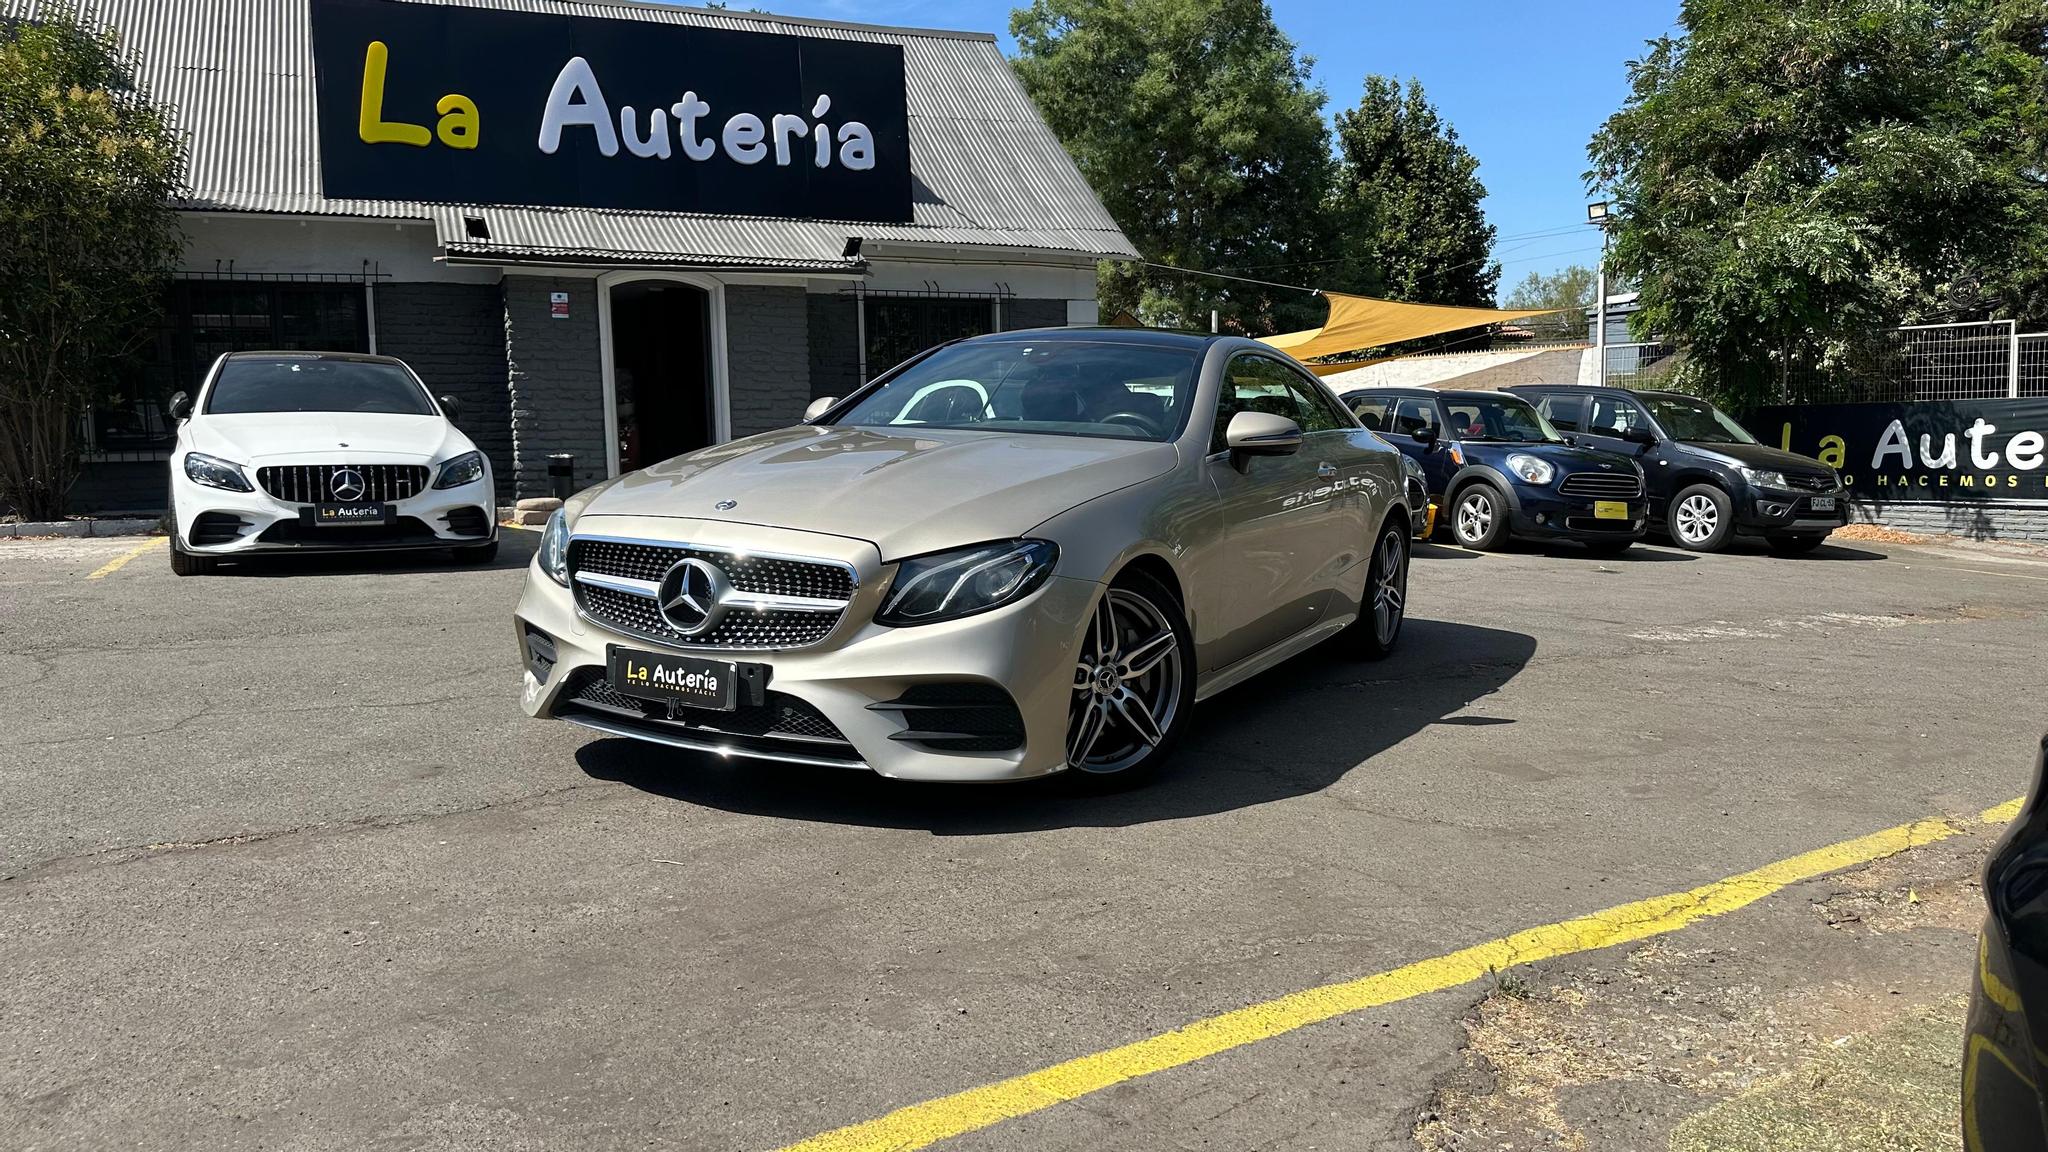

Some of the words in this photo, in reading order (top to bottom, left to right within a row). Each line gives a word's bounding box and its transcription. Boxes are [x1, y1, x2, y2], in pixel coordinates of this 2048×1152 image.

[359, 40, 480, 149] La
[538, 56, 876, 171] Autería
[1871, 418, 2045, 470] Aute
[1878, 474, 2018, 488] HACEMOS
[322, 508, 335, 516] La
[338, 506, 378, 515] Autería
[627, 660, 648, 680] La
[653, 664, 717, 690] Autería
[655, 683, 690, 692] HACEMOS
